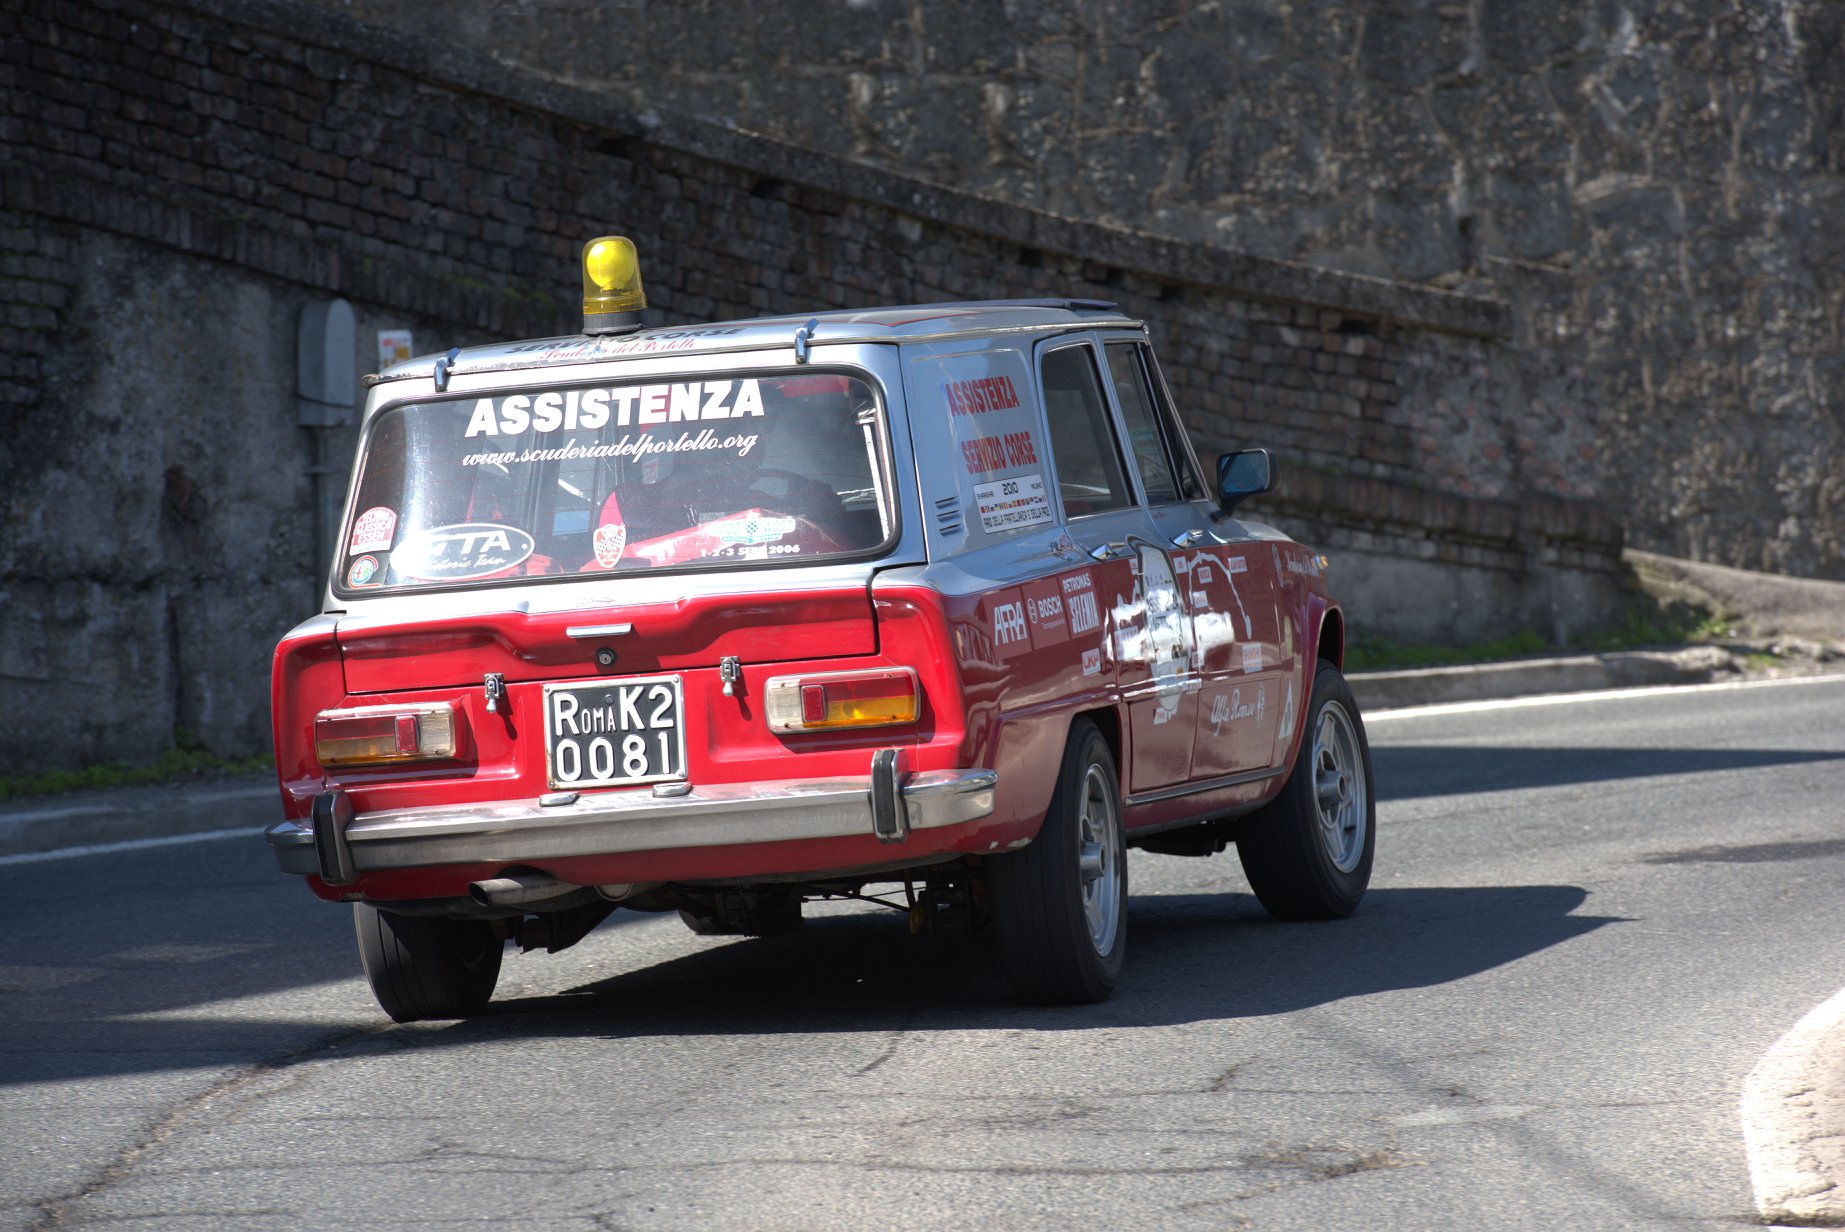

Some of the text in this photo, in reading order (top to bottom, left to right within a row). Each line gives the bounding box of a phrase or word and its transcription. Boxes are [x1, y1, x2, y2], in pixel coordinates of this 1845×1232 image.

[505, 327, 746, 354] SERVIIO CORSE
[465, 378, 765, 437] ASSISTENZA
[945, 375, 1020, 417] ASSISTENZA
[462, 429, 758, 467] www.scuderiadelportello.org
[960, 431, 1038, 475] SERVIZIO CORSE
[1001, 481, 1019, 496] 2010
[769, 544, 800, 554] 2006
[1062, 572, 1092, 594] PETRONAS
[993, 601, 1028, 646] AFRA
[1037, 595, 1063, 618] BOSCH
[1068, 590, 1100, 634] SELENIA
[619, 685, 675, 731] K2
[1211, 694, 1232, 736] Alfa
[1231, 688, 1254, 720] Romeo
[556, 731, 670, 782] 0081
